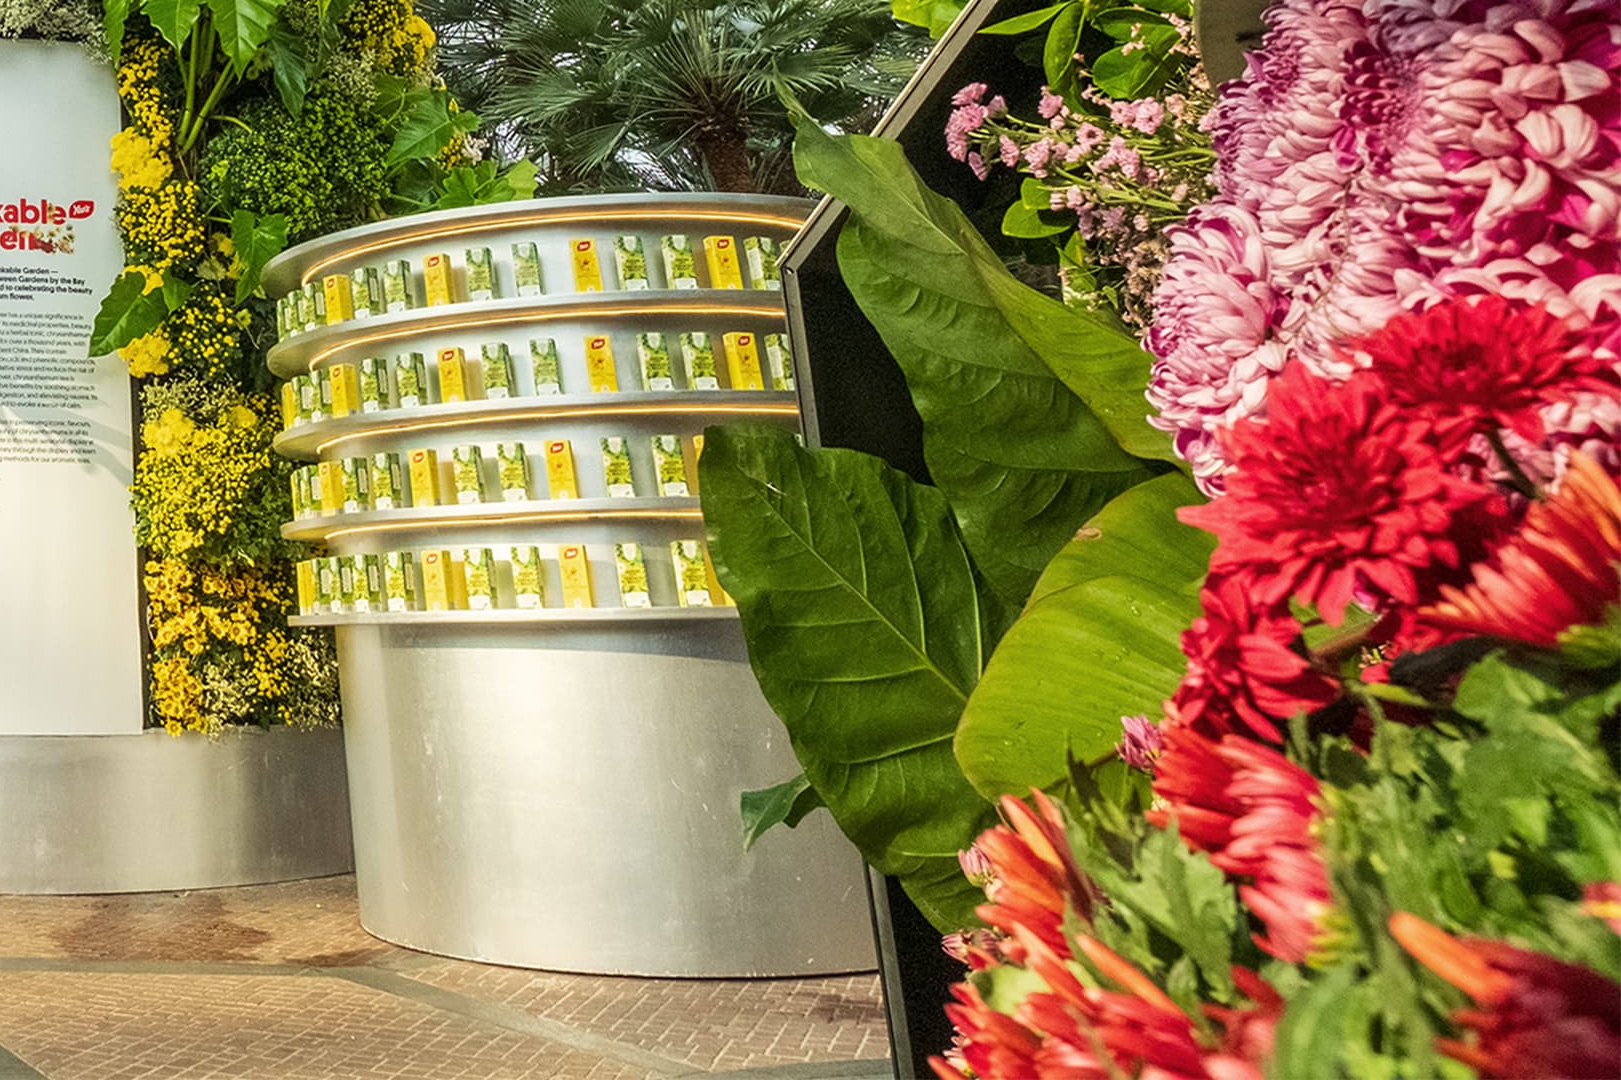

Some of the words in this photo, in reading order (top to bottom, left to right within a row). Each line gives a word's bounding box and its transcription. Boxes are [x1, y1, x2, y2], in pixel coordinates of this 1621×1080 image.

[23, 267, 50, 275] Garden
[19, 275, 49, 283] Gardens
[49, 276, 59, 285] by
[73, 277, 86, 287] Bay
[14, 284, 55, 294] celebrating
[68, 286, 93, 295] beauty
